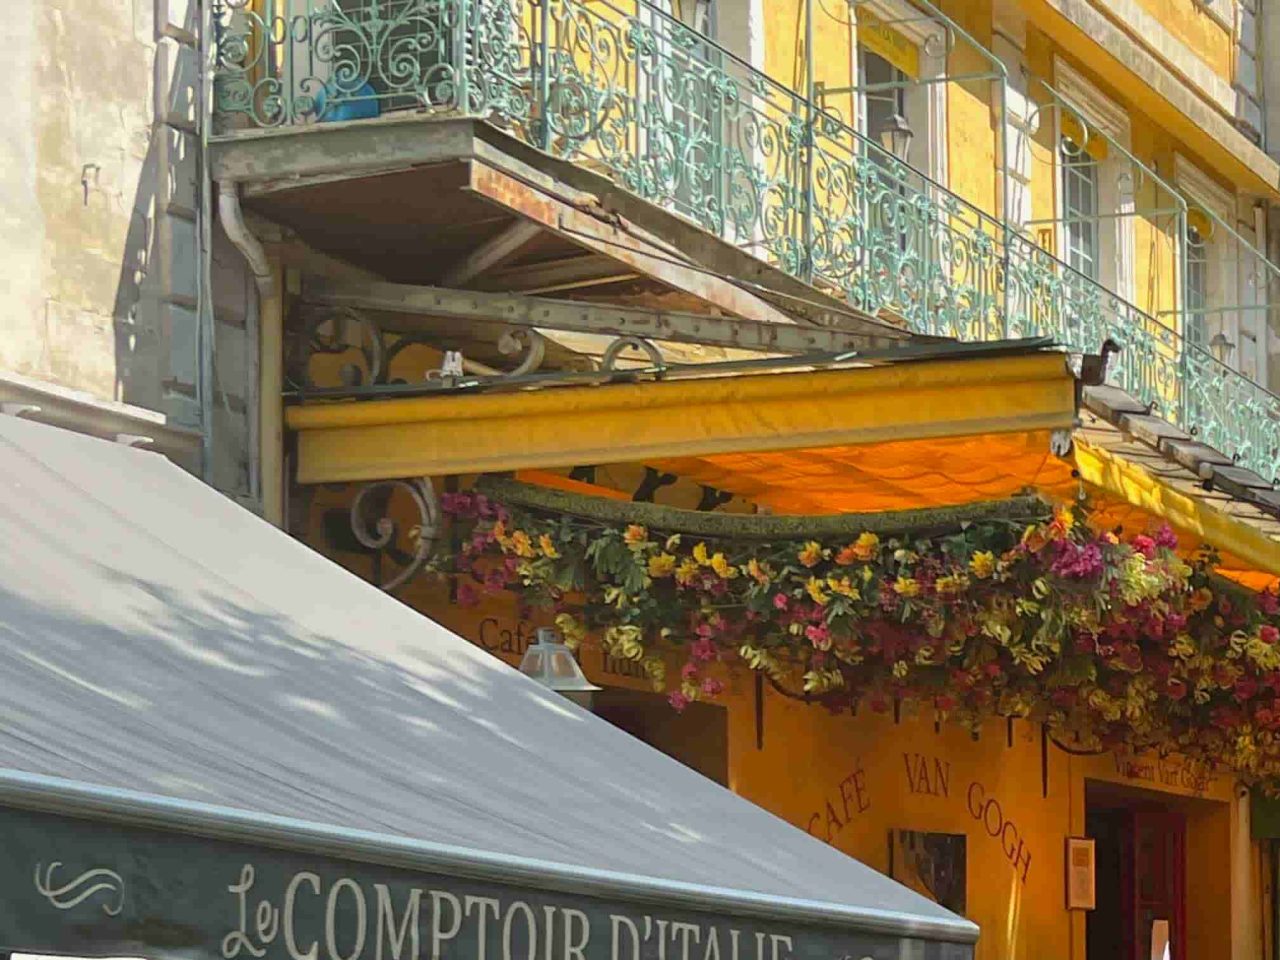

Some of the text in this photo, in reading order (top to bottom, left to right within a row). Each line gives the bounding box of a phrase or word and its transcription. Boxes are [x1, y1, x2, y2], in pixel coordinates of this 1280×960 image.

[904, 752, 950, 798] VAN
[967, 782, 1032, 884] GOGH
[222, 863, 279, 959] Le
